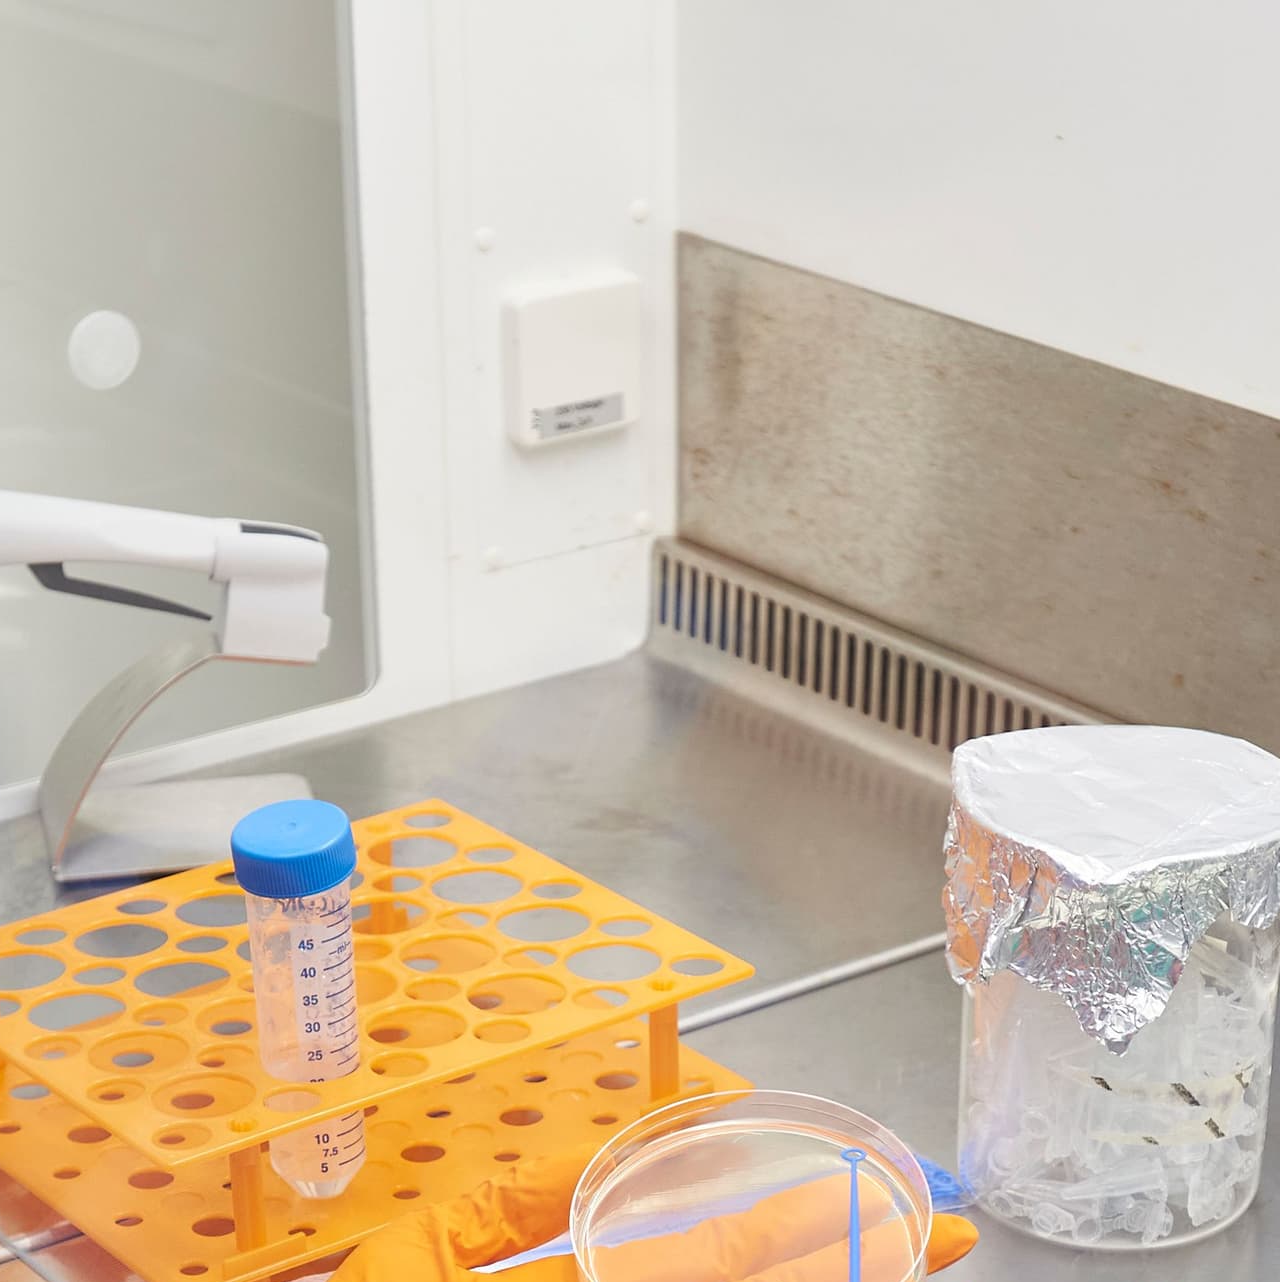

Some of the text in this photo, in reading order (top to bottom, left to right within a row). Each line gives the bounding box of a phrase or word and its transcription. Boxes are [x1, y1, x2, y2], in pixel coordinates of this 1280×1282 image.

[298, 938, 314, 951] 45
[300, 966, 316, 979] 40
[302, 994, 319, 1007] 35
[305, 1021, 321, 1034] 30
[307, 1049, 323, 1062] 25
[314, 1133, 330, 1145] 10
[322, 1146, 339, 1157] 7.5
[321, 1162, 329, 1173] 5
